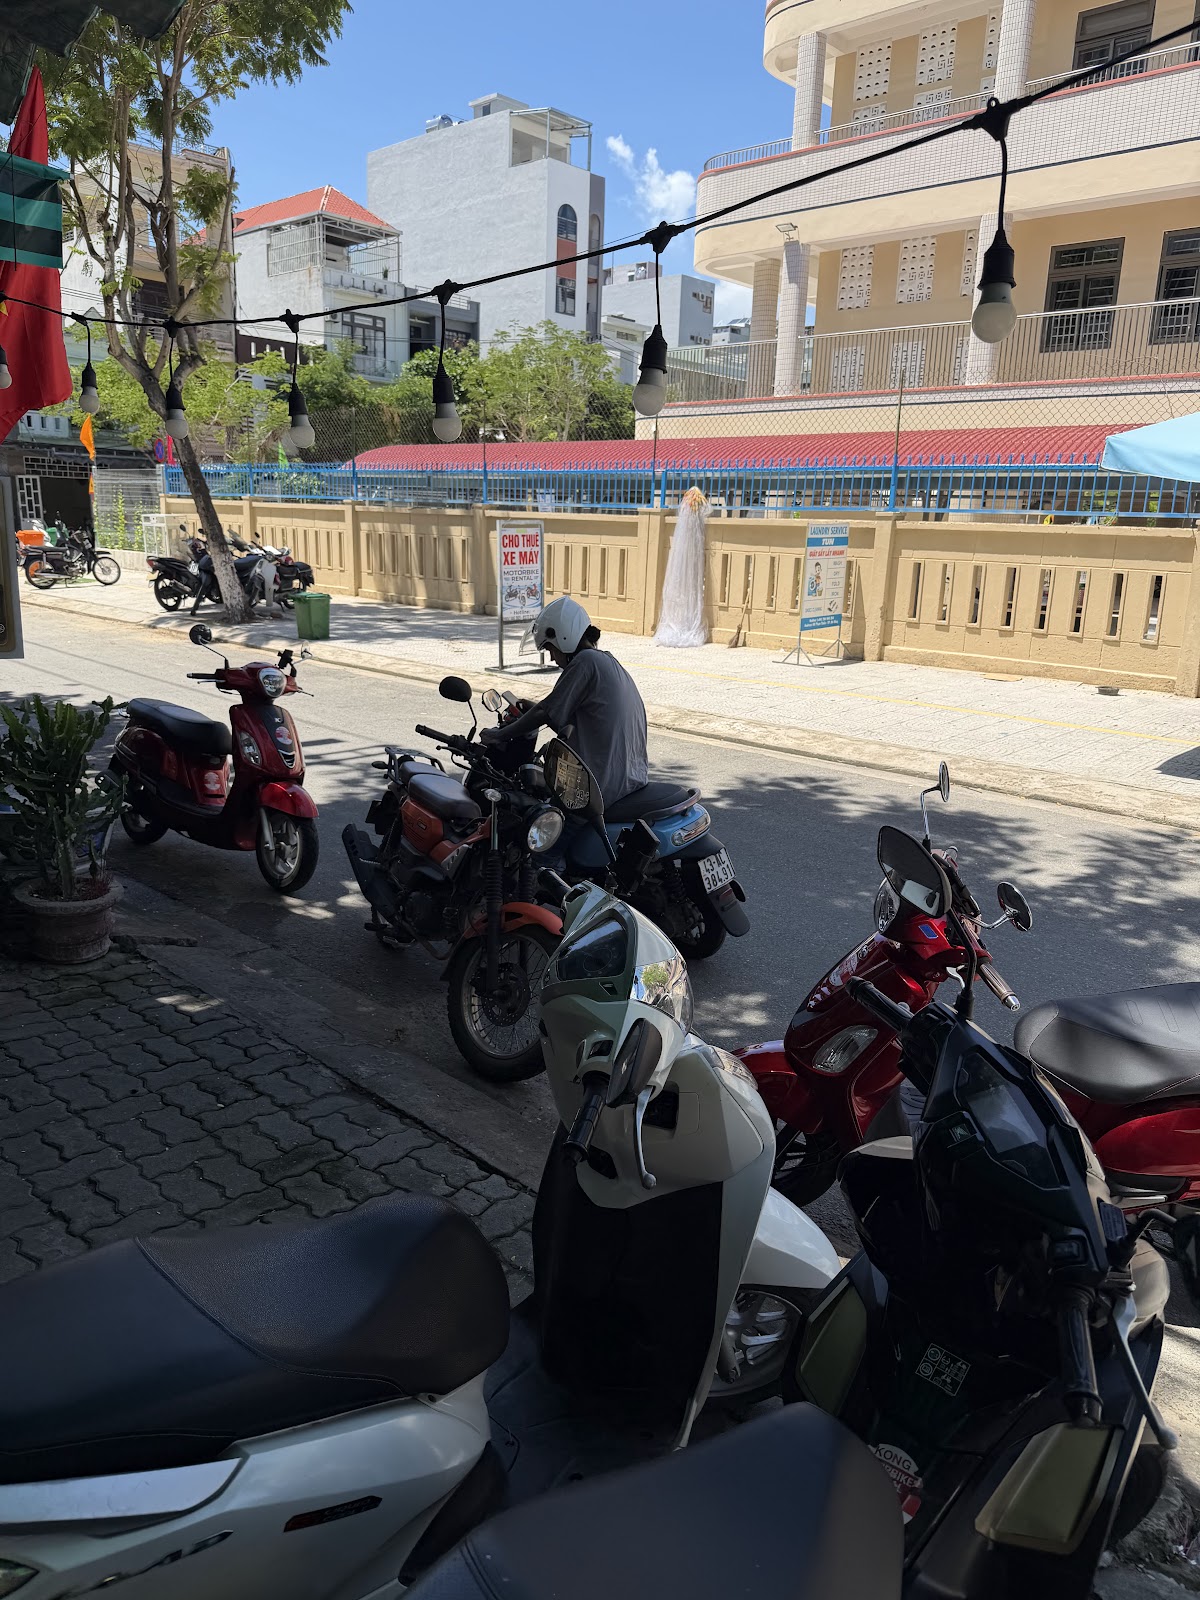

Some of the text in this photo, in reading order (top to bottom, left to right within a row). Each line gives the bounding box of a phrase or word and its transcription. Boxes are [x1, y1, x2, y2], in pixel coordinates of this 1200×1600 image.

[810, 526, 848, 535] LAUNDRY SERVICE
[502, 532, 540, 548] CHO THUÊ
[503, 548, 540, 566] XE MÁY
[874, 1446, 912, 1471] KONG
